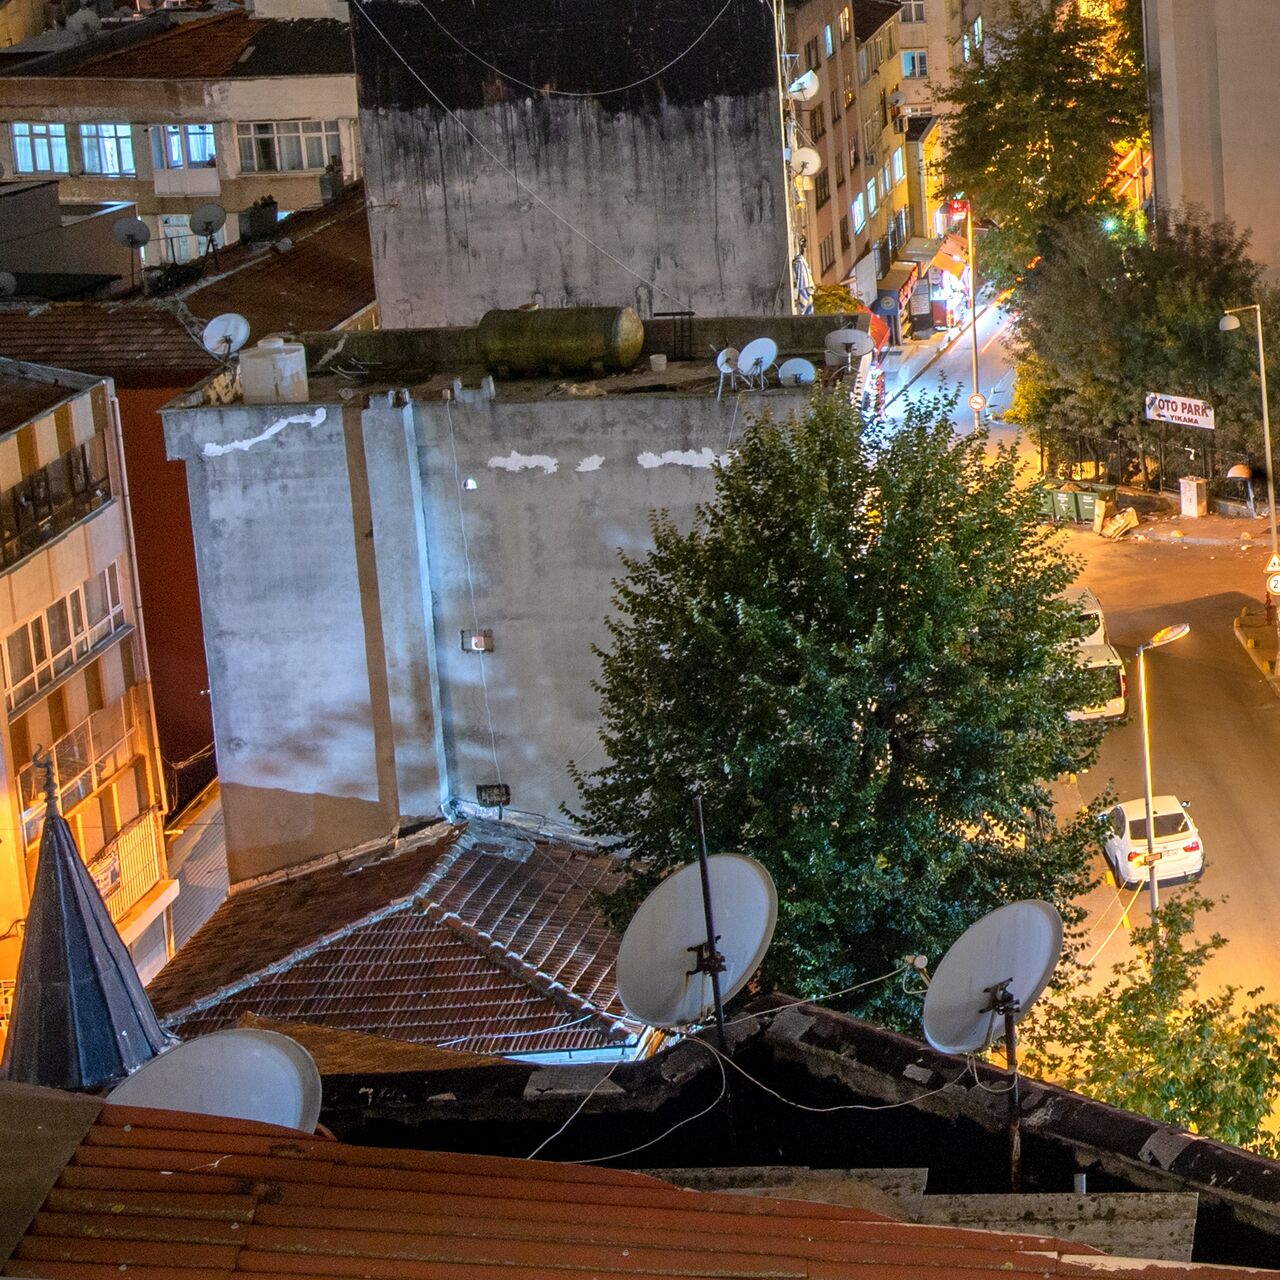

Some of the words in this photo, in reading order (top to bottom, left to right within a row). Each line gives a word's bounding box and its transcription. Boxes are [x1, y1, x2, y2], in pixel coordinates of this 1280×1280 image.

[1158, 399, 1178, 412] OTO
[1181, 402, 1209, 417] PARK
[1170, 415, 1199, 425] YIKAMA
